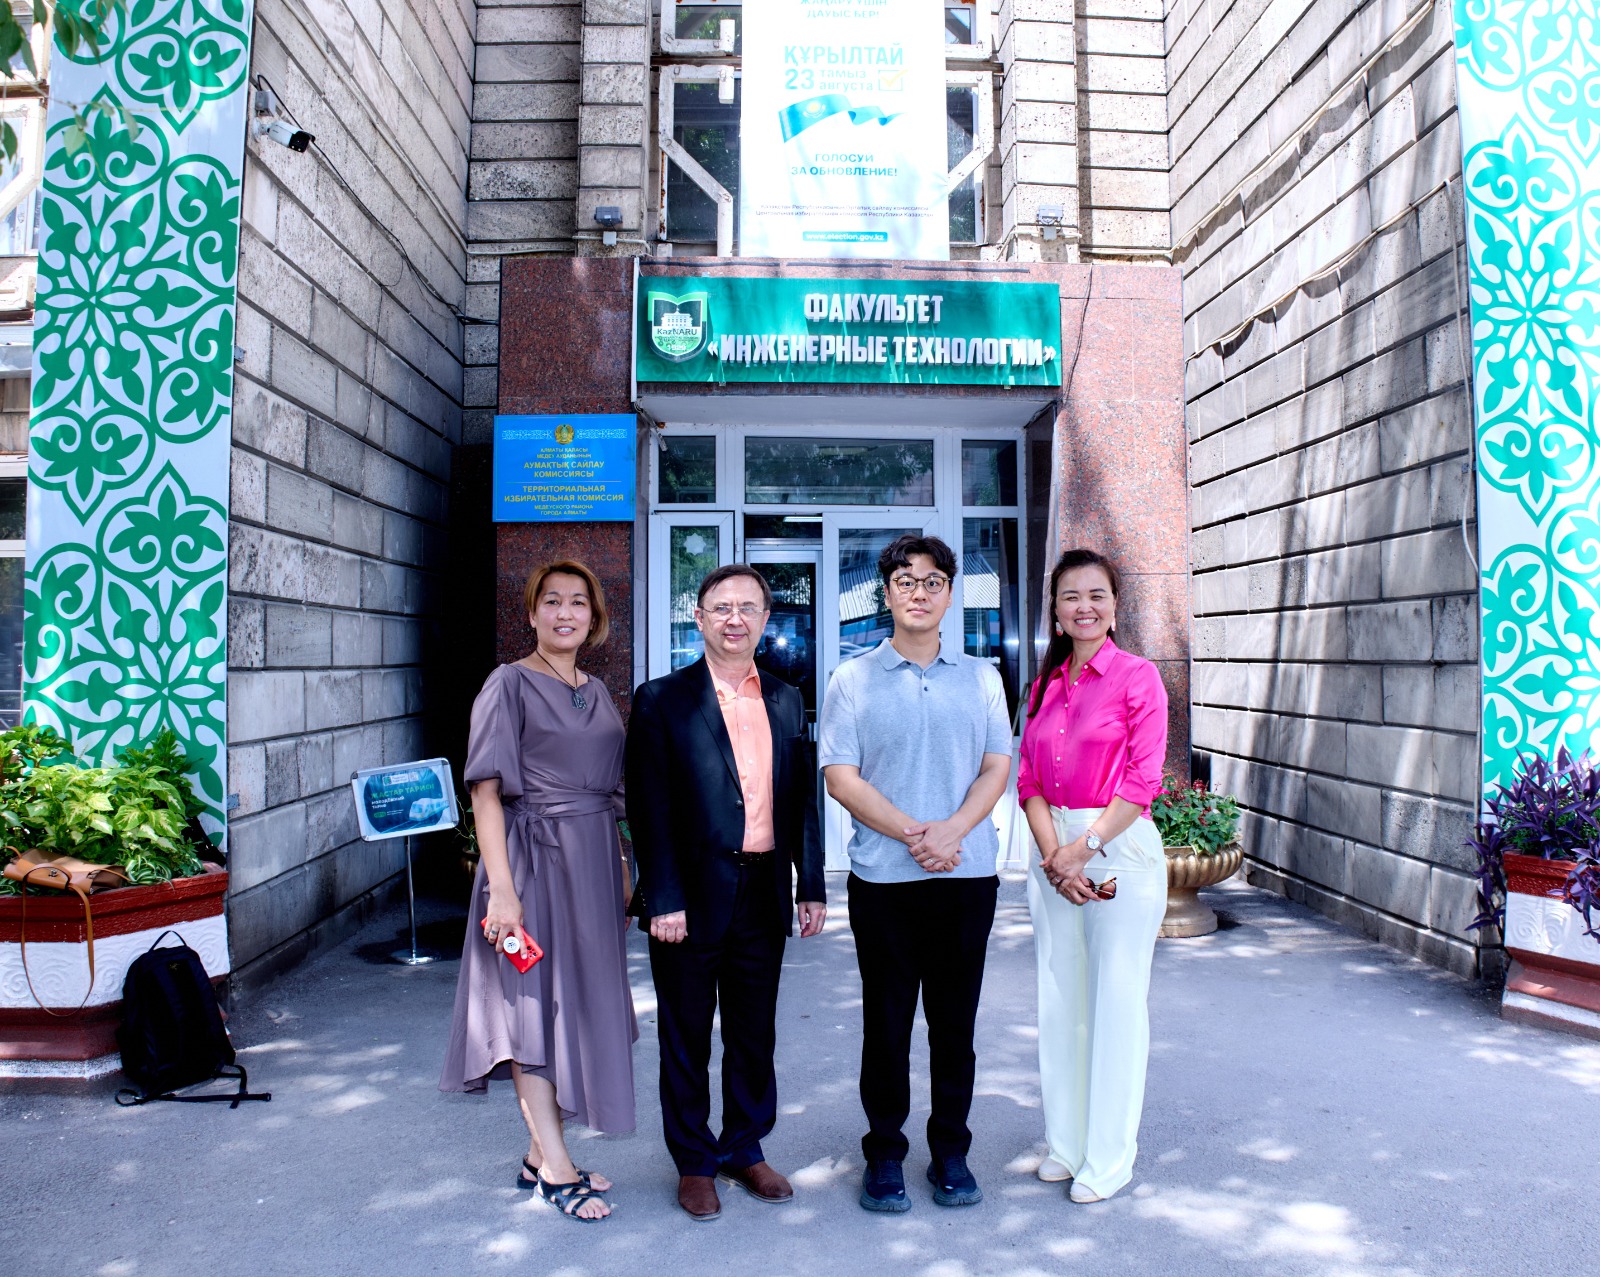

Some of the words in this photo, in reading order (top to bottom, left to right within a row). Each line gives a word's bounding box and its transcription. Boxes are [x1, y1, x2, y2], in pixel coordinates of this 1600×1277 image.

[784, 42, 903, 66] ҚҰРЫЛТАЙ
[784, 68, 815, 90] 23
[819, 69, 867, 79] тамыз
[819, 81, 873, 92] августа
[791, 166, 807, 175] ЗА
[809, 166, 898, 177] ОБНОВЛЕНИЕ!
[805, 233, 884, 242] www.election.gov.kz
[804, 293, 944, 324] ФАКУЛЬТЕТ
[657, 328, 698, 336] KazNARU
[707, 334, 888, 364] «ИНЖЕНЕРНЫЕ
[891, 336, 1056, 367] ТЕХНОЛОГИИ»
[524, 461, 570, 470] АУМАҚТЫҚ
[571, 460, 604, 469] САЙЛАУ
[534, 470, 594, 478] КОМИССИЯСЫ
[522, 485, 606, 493] ТЕРРИТОРИАЛЬНАЯ
[504, 494, 575, 502] ИЗБИРАТЕЛЬНАЯ
[577, 494, 624, 502] КОМИССИЯ
[371, 789, 404, 798] ЖАСТАР
